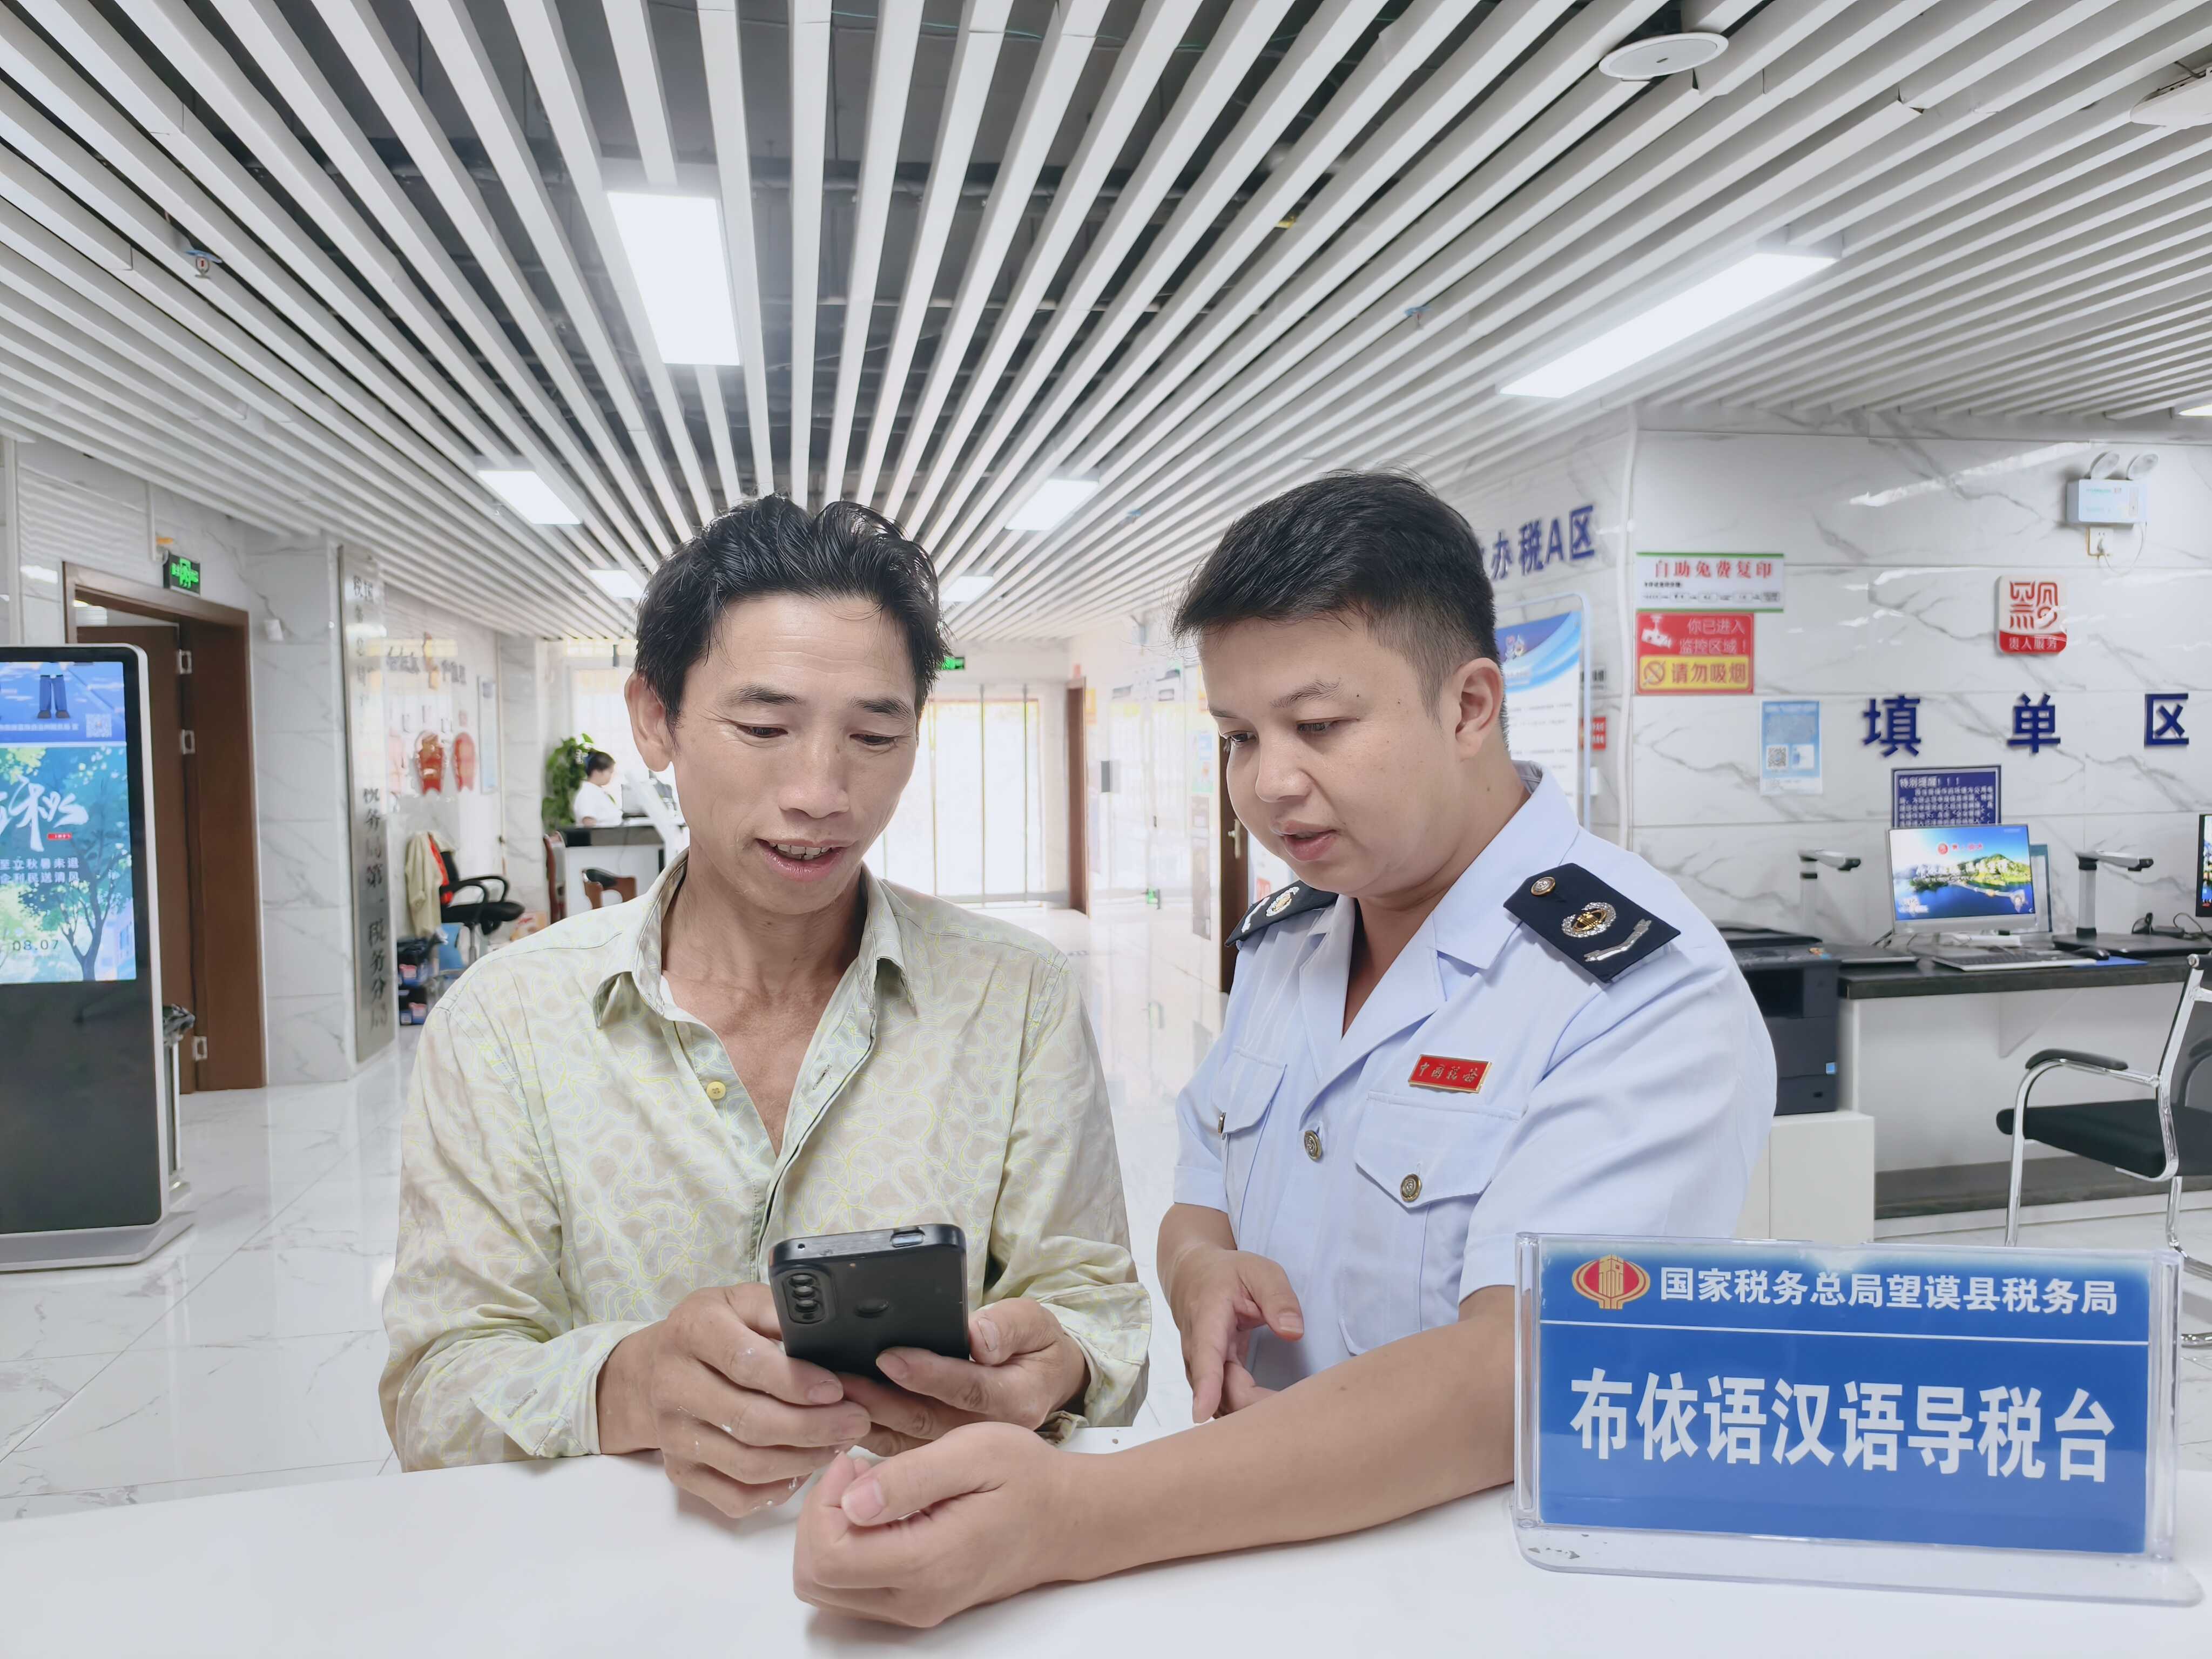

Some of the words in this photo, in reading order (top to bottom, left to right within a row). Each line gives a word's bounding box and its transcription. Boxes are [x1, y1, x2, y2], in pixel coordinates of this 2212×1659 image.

[1479, 504, 1595, 580] 办税A区
[1655, 560, 1772, 578] 自助免费复印
[1687, 618, 1745, 635] 你已进入
[2009, 637, 2057, 650] 贵人服务
[1671, 663, 1746, 684] 请勿吸烟
[1863, 692, 2189, 757] 填单区
[12, 939, 59, 951] 08.07
[1660, 1267, 2117, 1316] 国家税务总局望谟县税务局
[1569, 1367, 2115, 1482] 布依语汉语导税台
